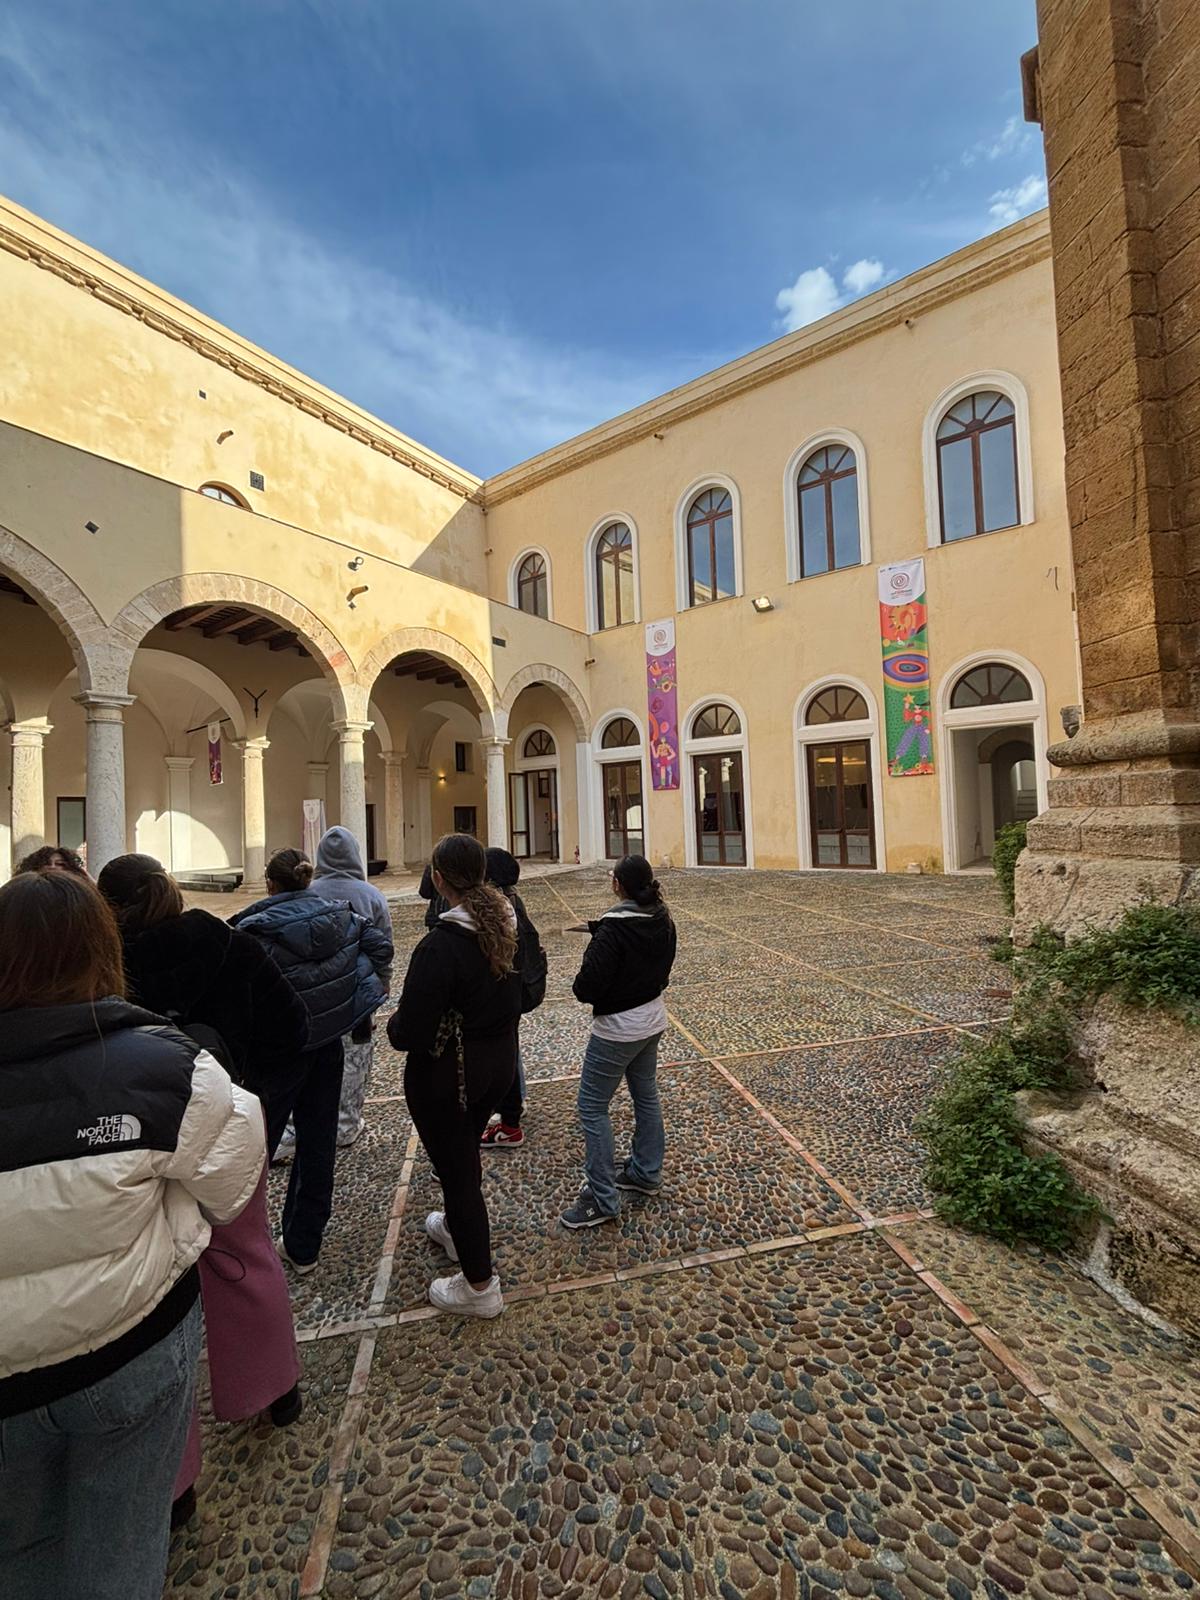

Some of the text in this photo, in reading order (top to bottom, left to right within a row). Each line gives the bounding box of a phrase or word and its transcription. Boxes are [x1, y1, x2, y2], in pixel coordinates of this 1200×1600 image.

[97, 1114, 121, 1126] THE
[77, 1124, 120, 1139] NORTH
[88, 1133, 119, 1146] FACE
